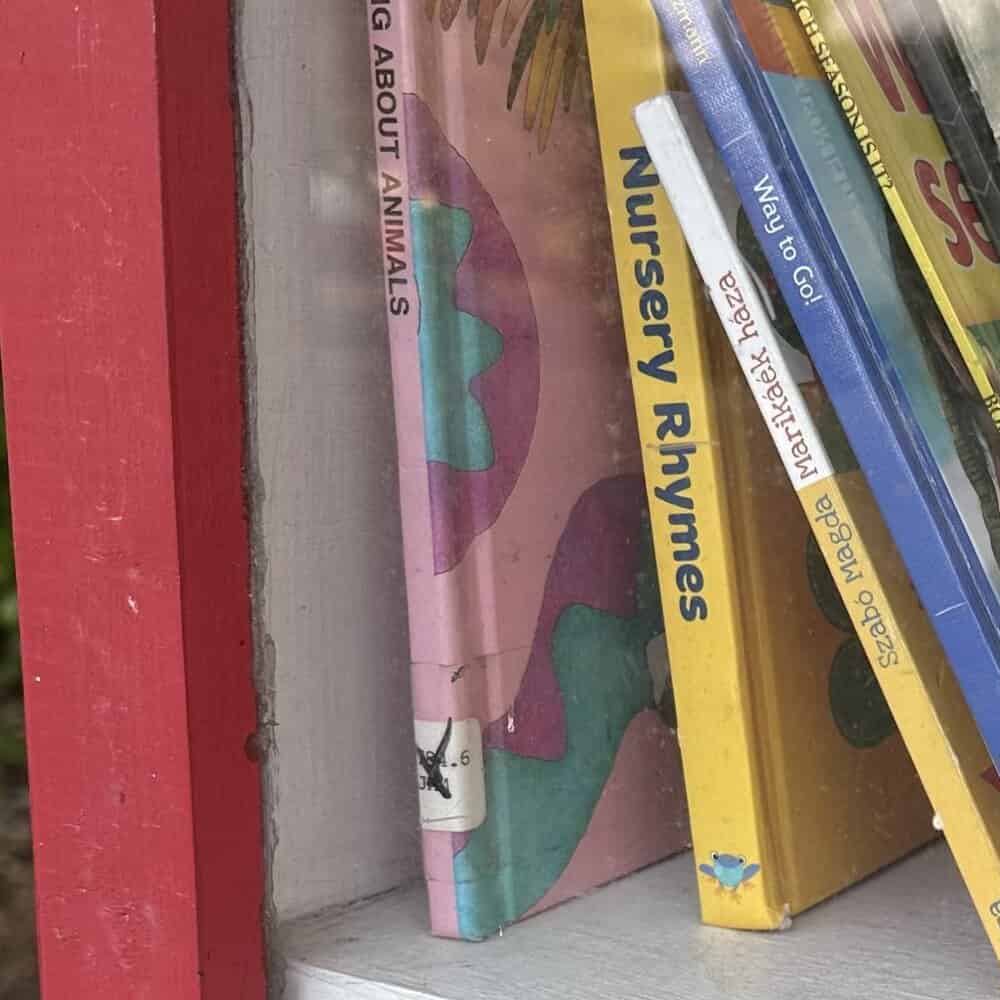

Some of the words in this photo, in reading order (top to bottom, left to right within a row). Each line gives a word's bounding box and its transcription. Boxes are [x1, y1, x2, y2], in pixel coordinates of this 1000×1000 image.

[373, 44, 400, 159] ABOUT
[812, 38, 866, 131] SEASON
[857, 134, 877, 157] IS
[381, 172, 410, 317] ANIMALS
[754, 175, 785, 235] Way
[778, 235, 797, 261] to
[793, 265, 823, 306] Go!
[717, 270, 760, 342] háza
[618, 146, 678, 385] Nursery
[652, 402, 708, 623] Rhymes
[748, 345, 819, 482] Marikáék
[813, 493, 864, 584] Magda
[855, 587, 900, 670] Szabó
